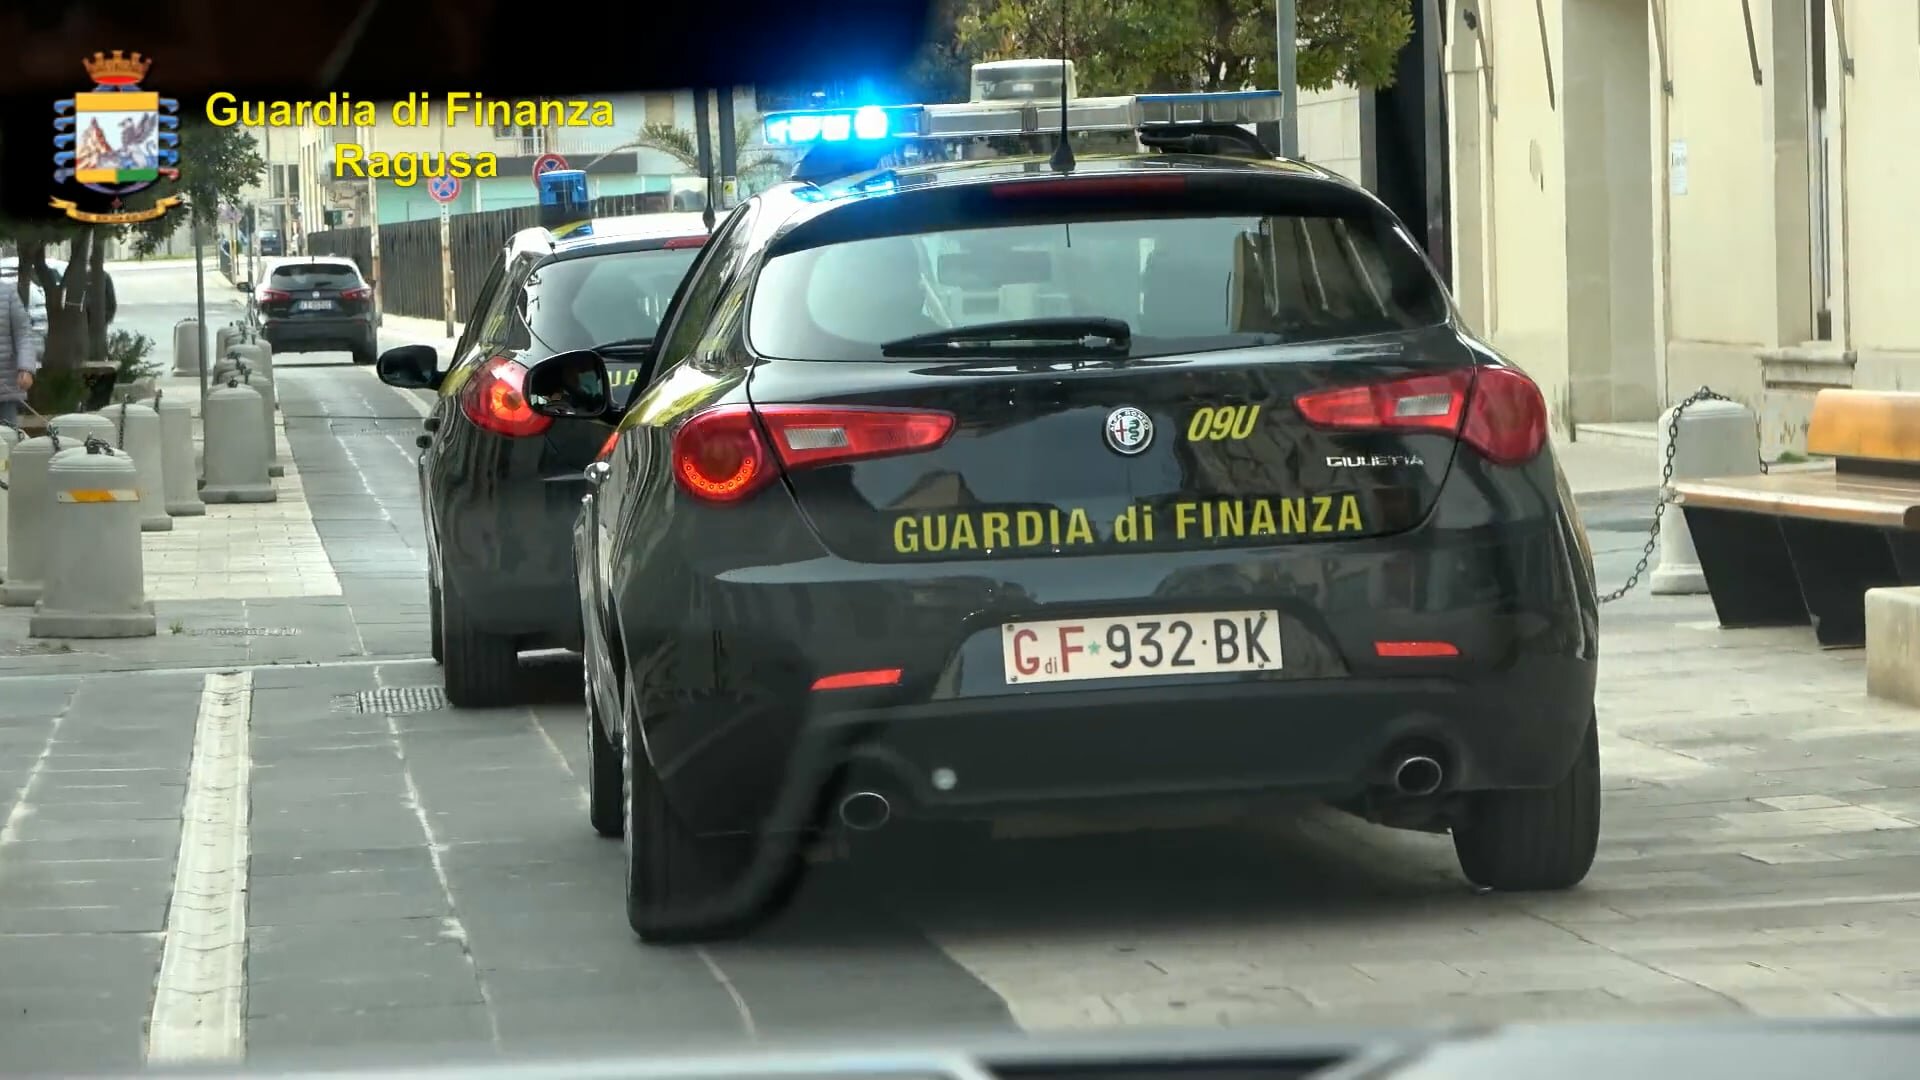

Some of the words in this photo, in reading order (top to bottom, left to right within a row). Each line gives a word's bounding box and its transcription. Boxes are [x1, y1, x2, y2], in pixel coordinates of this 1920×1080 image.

[1187, 405, 1260, 441] 09U
[893, 508, 1093, 553] GUARDIA
[1114, 506, 1153, 542] di
[1176, 496, 1363, 540] FINANZA
